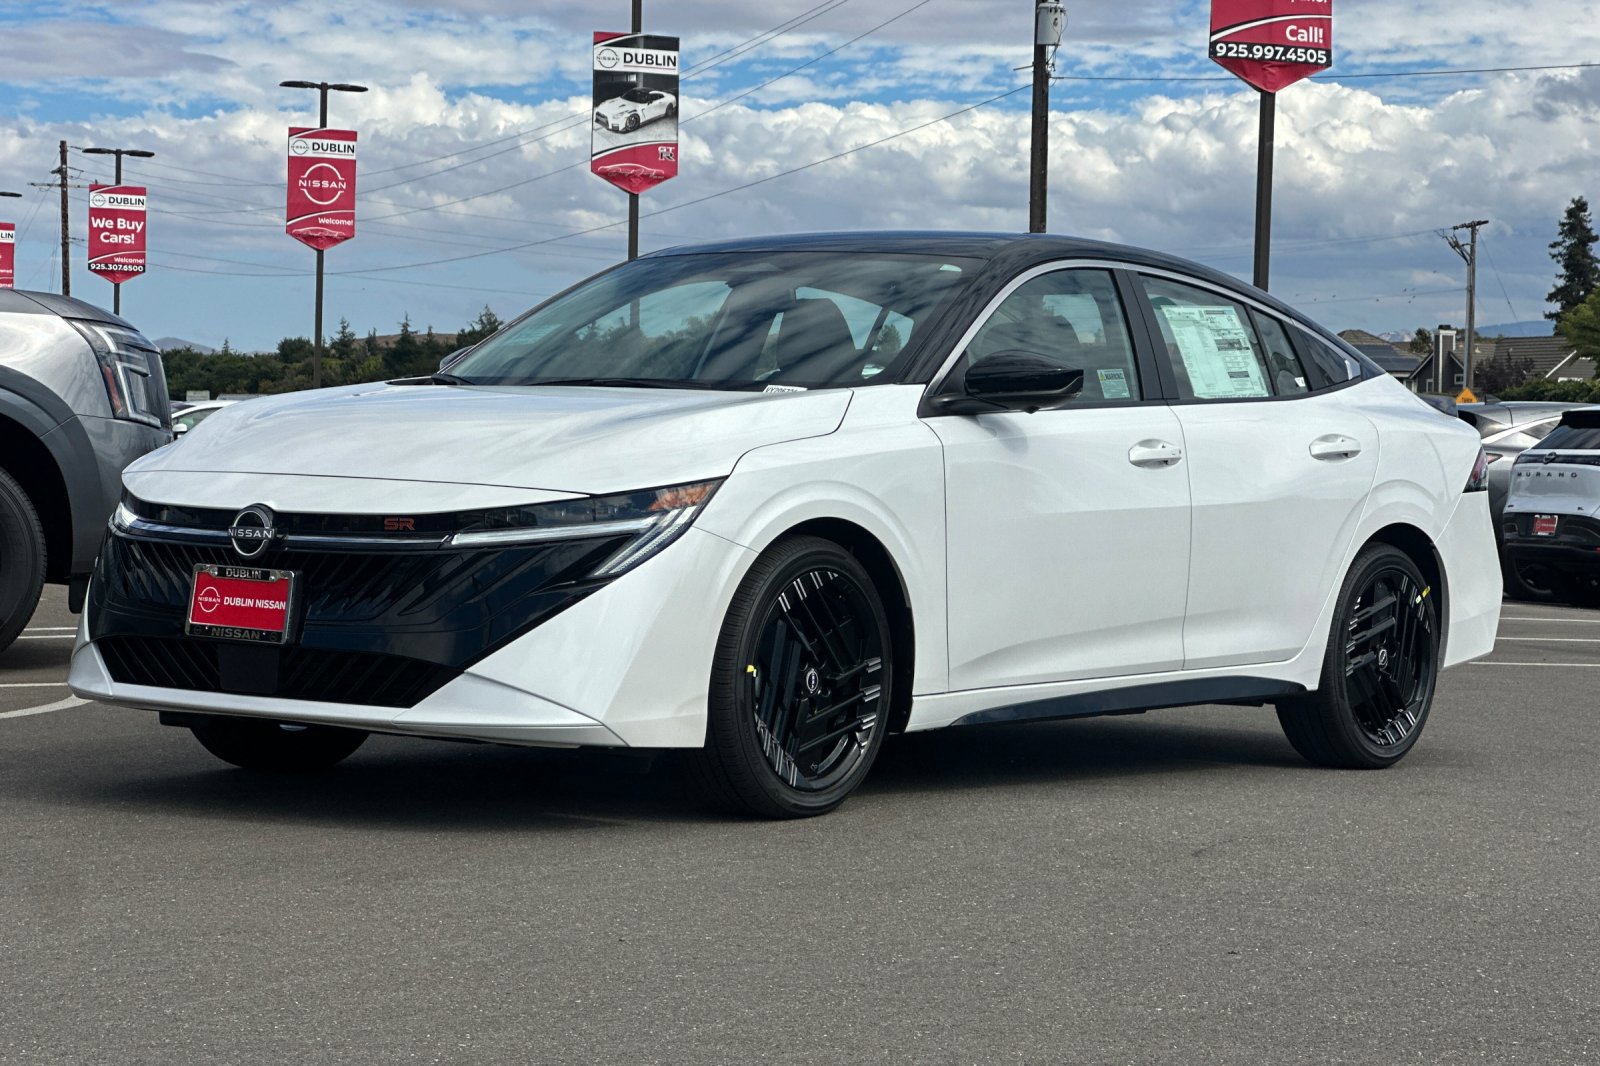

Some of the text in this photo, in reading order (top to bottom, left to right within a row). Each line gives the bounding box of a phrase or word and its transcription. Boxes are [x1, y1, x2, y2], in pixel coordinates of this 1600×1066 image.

[1285, 25, 1323, 43] Call!
[1215, 43, 1327, 63] 925.997.4505
[623, 52, 677, 67] DUBLIN
[312, 142, 355, 153] DUBLIN
[299, 179, 346, 189] NISSAN
[108, 196, 145, 206] DUBLIN
[91, 217, 144, 233] We Buy
[318, 217, 354, 226] Welcome!
[100, 232, 135, 244] Cars!
[113, 256, 145, 264] Welcome!
[383, 517, 415, 531] SR
[228, 527, 275, 538] NISSAN
[225, 568, 262, 580] DUBLIN
[223, 596, 254, 608] DUBLIN
[255, 599, 286, 610] NISSAN
[211, 627, 260, 641] NISSAN
